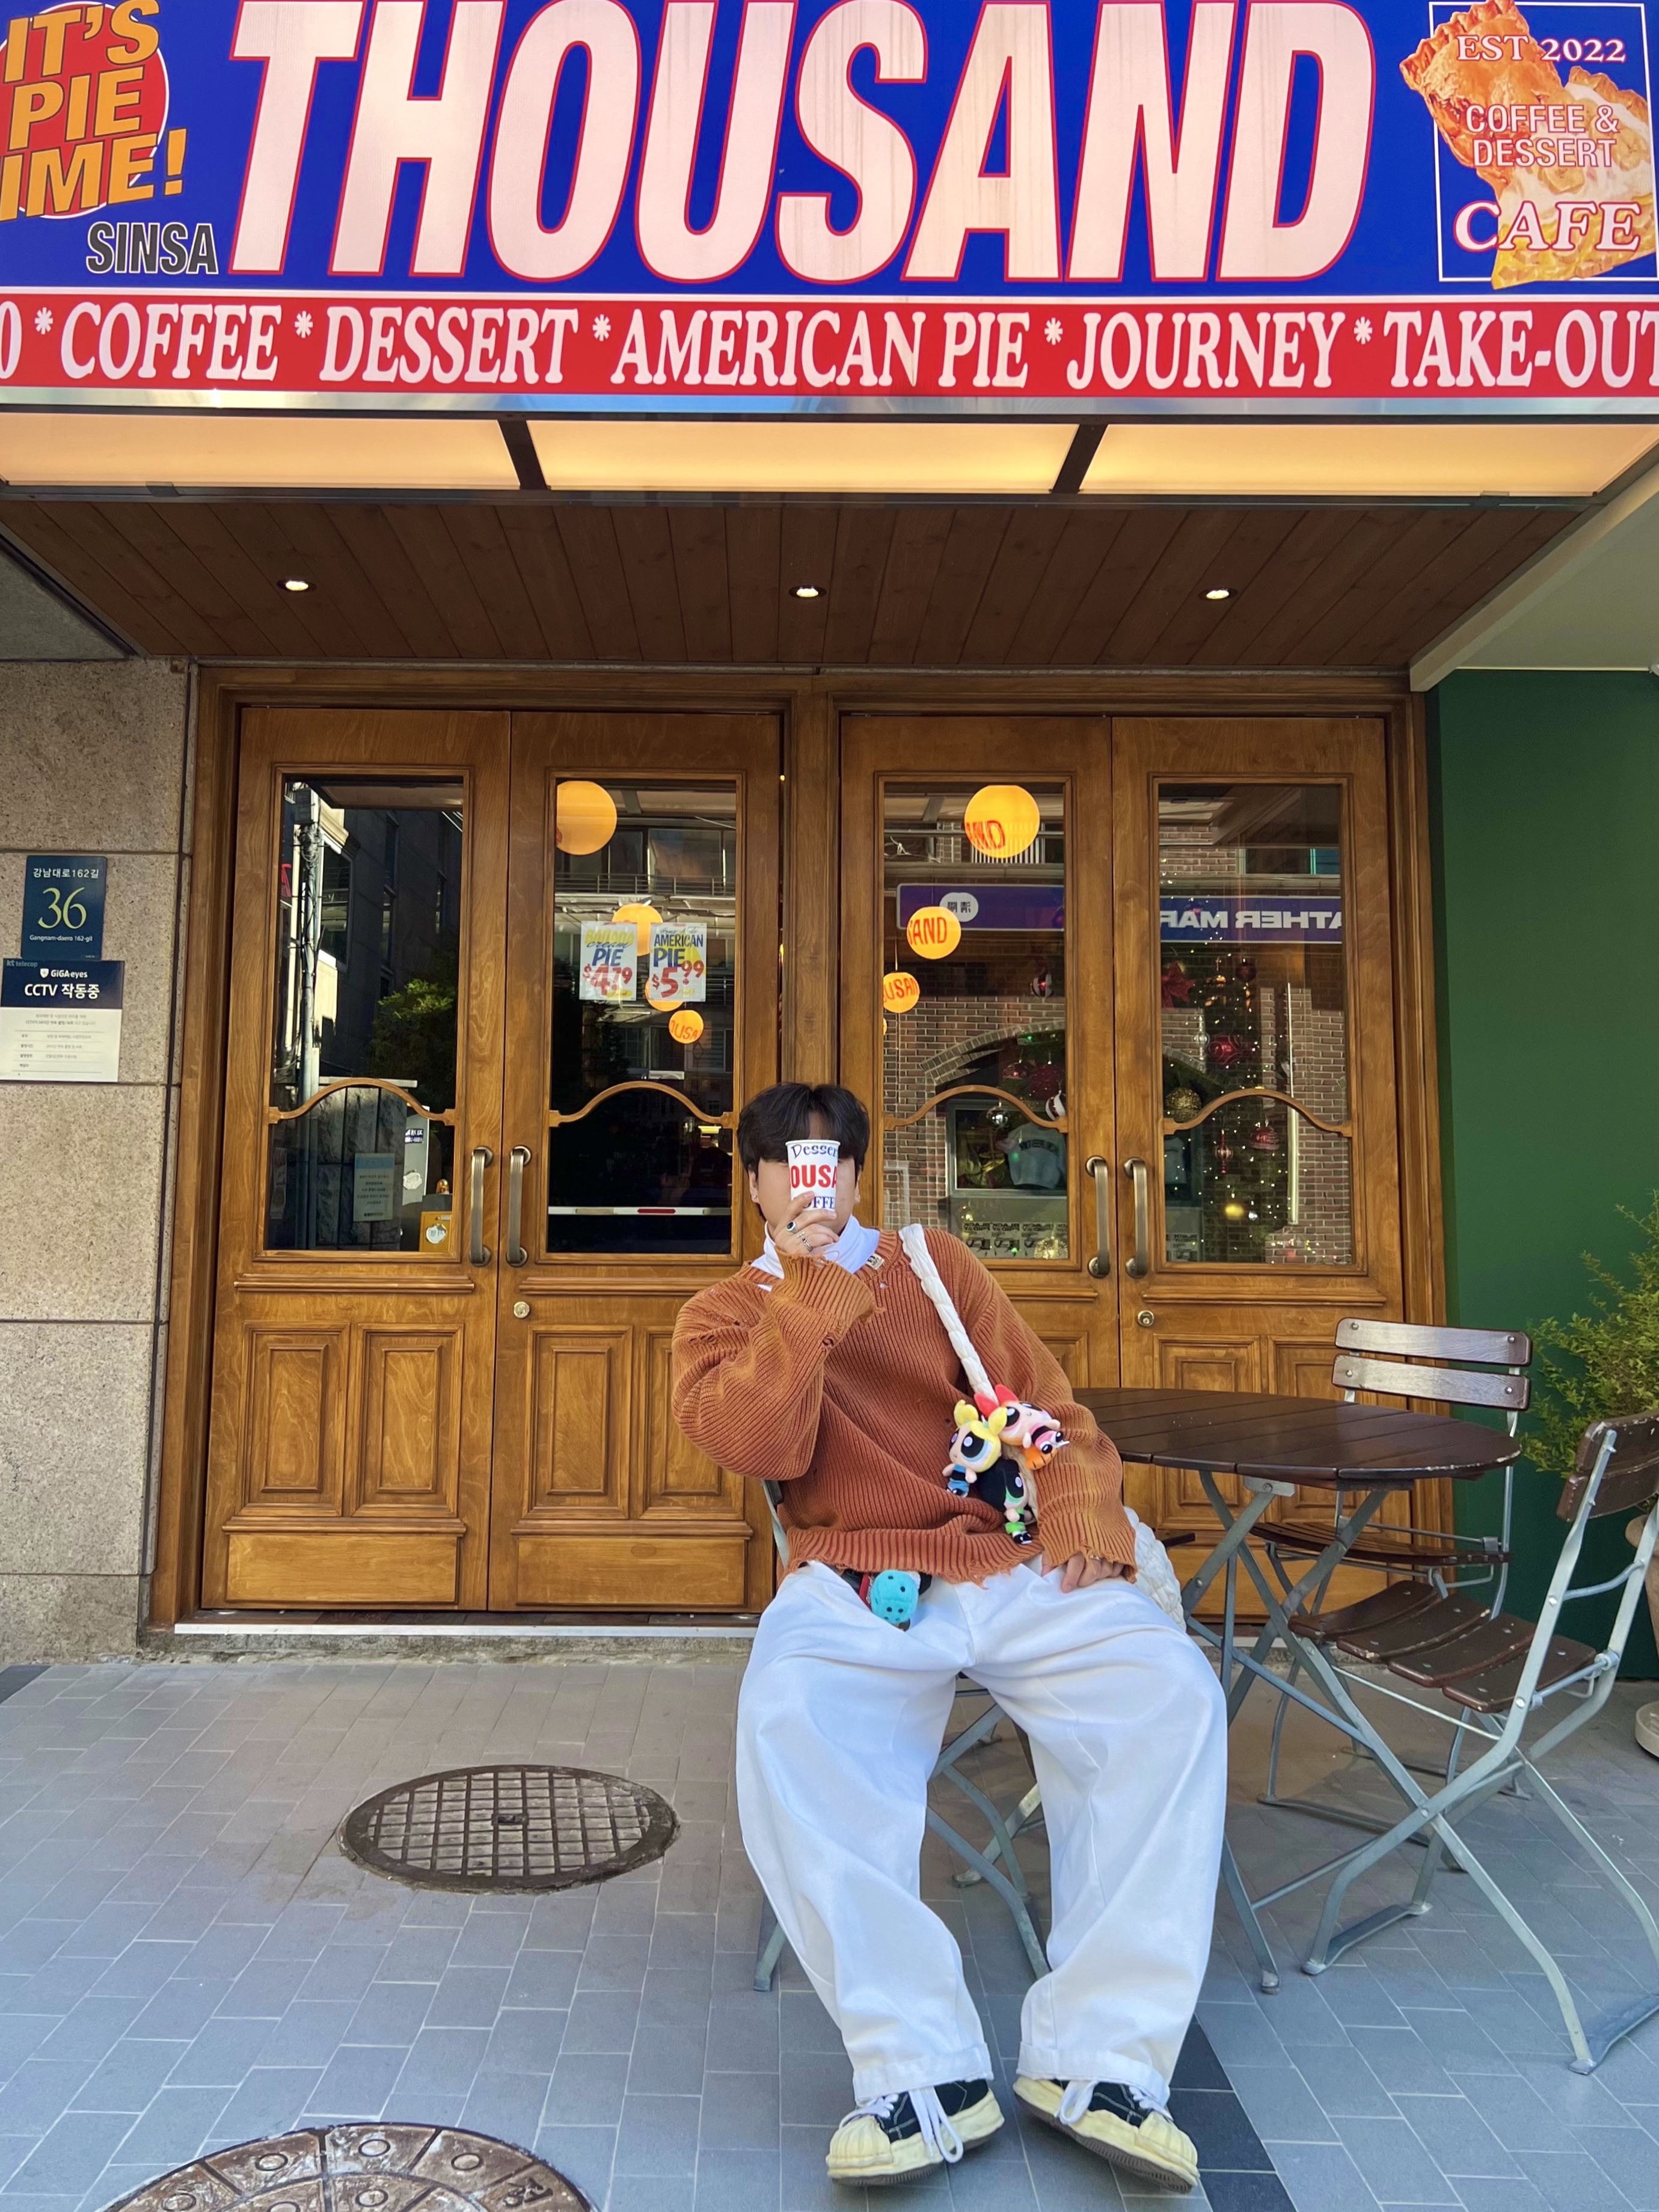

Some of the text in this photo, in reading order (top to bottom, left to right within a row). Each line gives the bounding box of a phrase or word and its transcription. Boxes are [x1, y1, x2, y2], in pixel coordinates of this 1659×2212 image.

[3, 0, 160, 84] IT'S
[1456, 35, 1627, 63] EST 2022
[7, 64, 146, 152] PIE
[1465, 104, 1621, 133] COFFEE &
[228, 0, 1376, 284] THOUSAND
[1473, 138, 1616, 167] DESSERT
[1453, 200, 1642, 252] CAFE
[85, 221, 219, 275] SINSA
[61, 302, 282, 382] COFFEE
[319, 306, 579, 384] DESSERT
[610, 308, 927, 387] AMERICAN
[938, 311, 1030, 389] PIE
[1066, 311, 1346, 390] JOURNEY
[33, 868, 99, 879] 강남대로162길
[38, 887, 87, 929] 36
[654, 934, 704, 947] AMERICAN
[592, 948, 624, 966] PIE
[653, 948, 685, 967] PIE
[25, 983, 100, 999] CCTV 작동중
